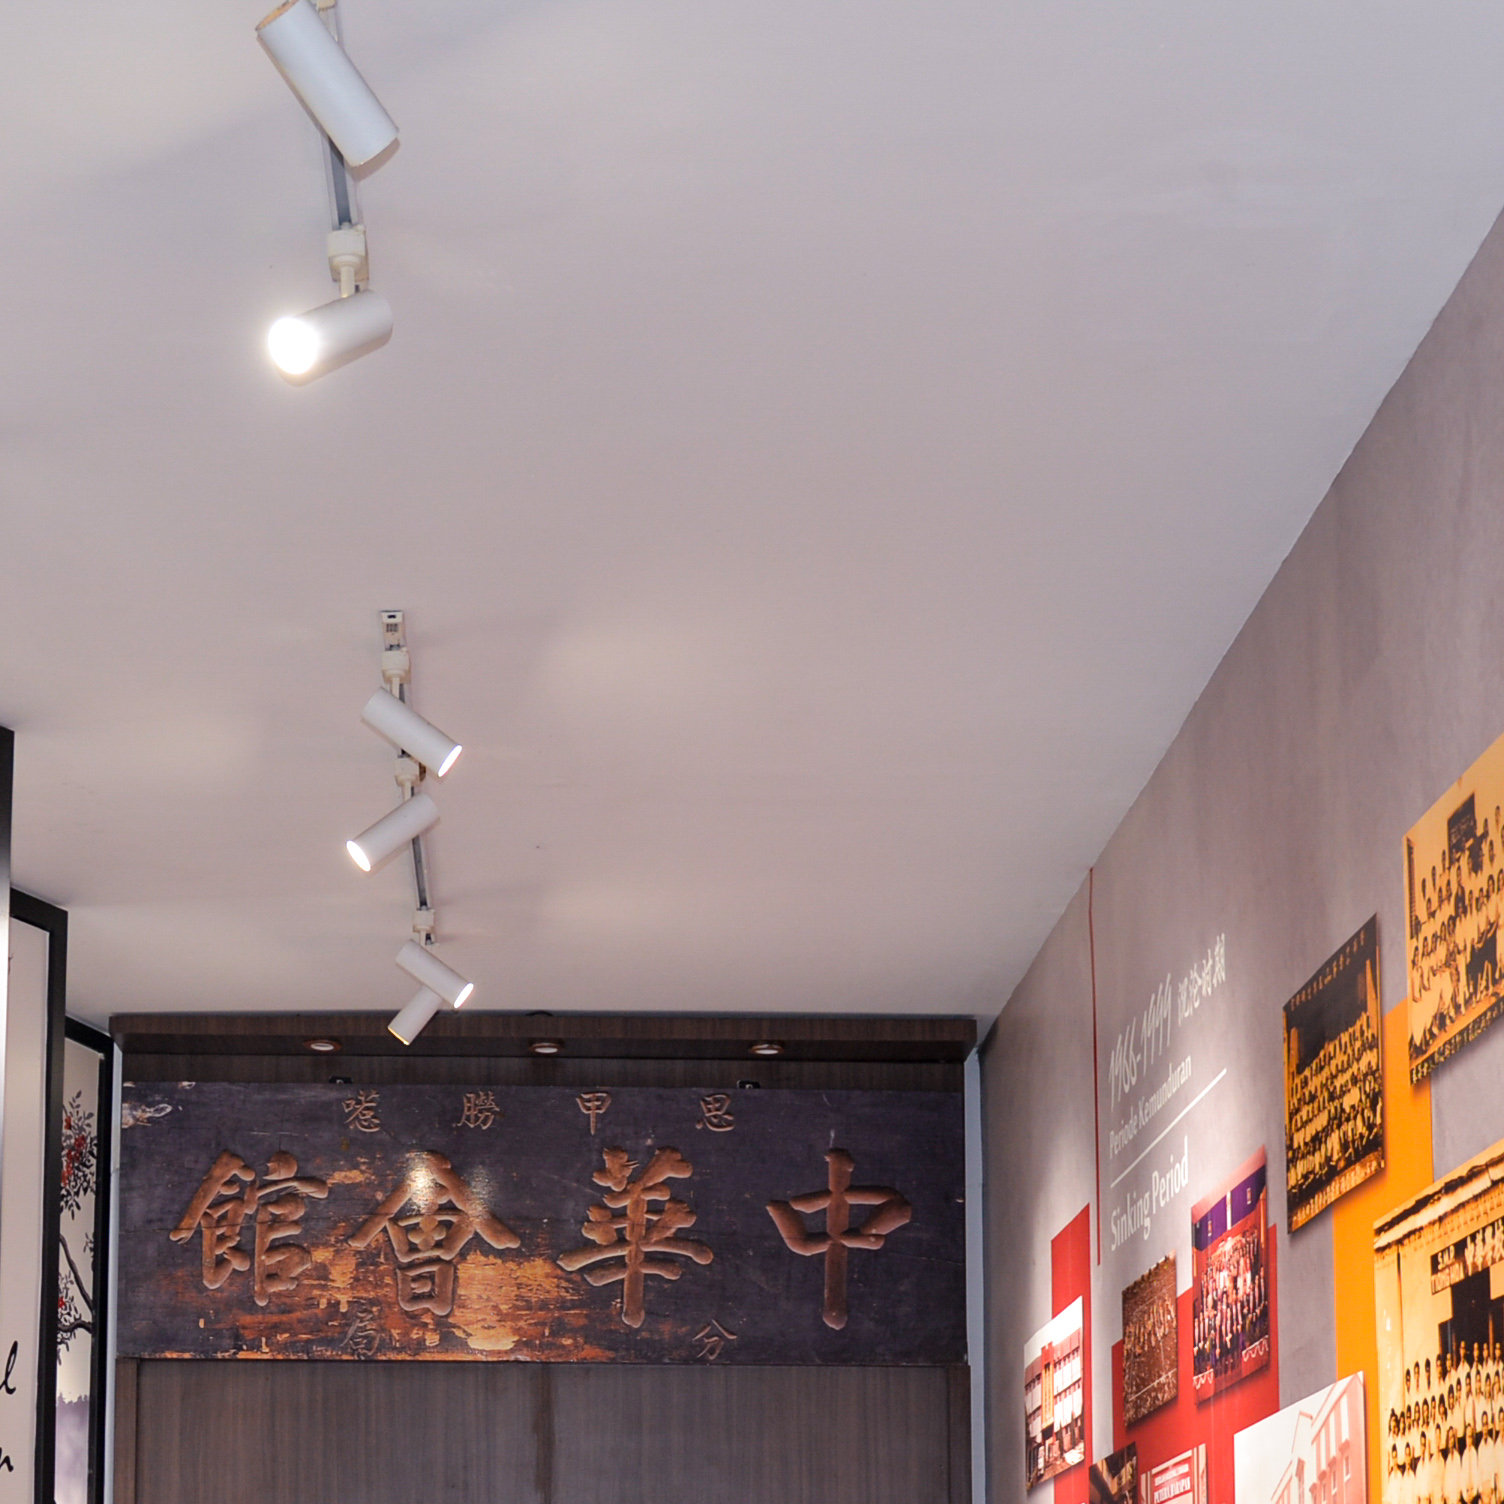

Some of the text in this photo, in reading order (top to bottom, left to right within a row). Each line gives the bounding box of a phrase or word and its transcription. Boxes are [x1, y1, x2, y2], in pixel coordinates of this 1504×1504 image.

[1109, 1054, 1192, 1160] Periode Kemunduran
[1110, 1135, 1189, 1251] Sinking Period
